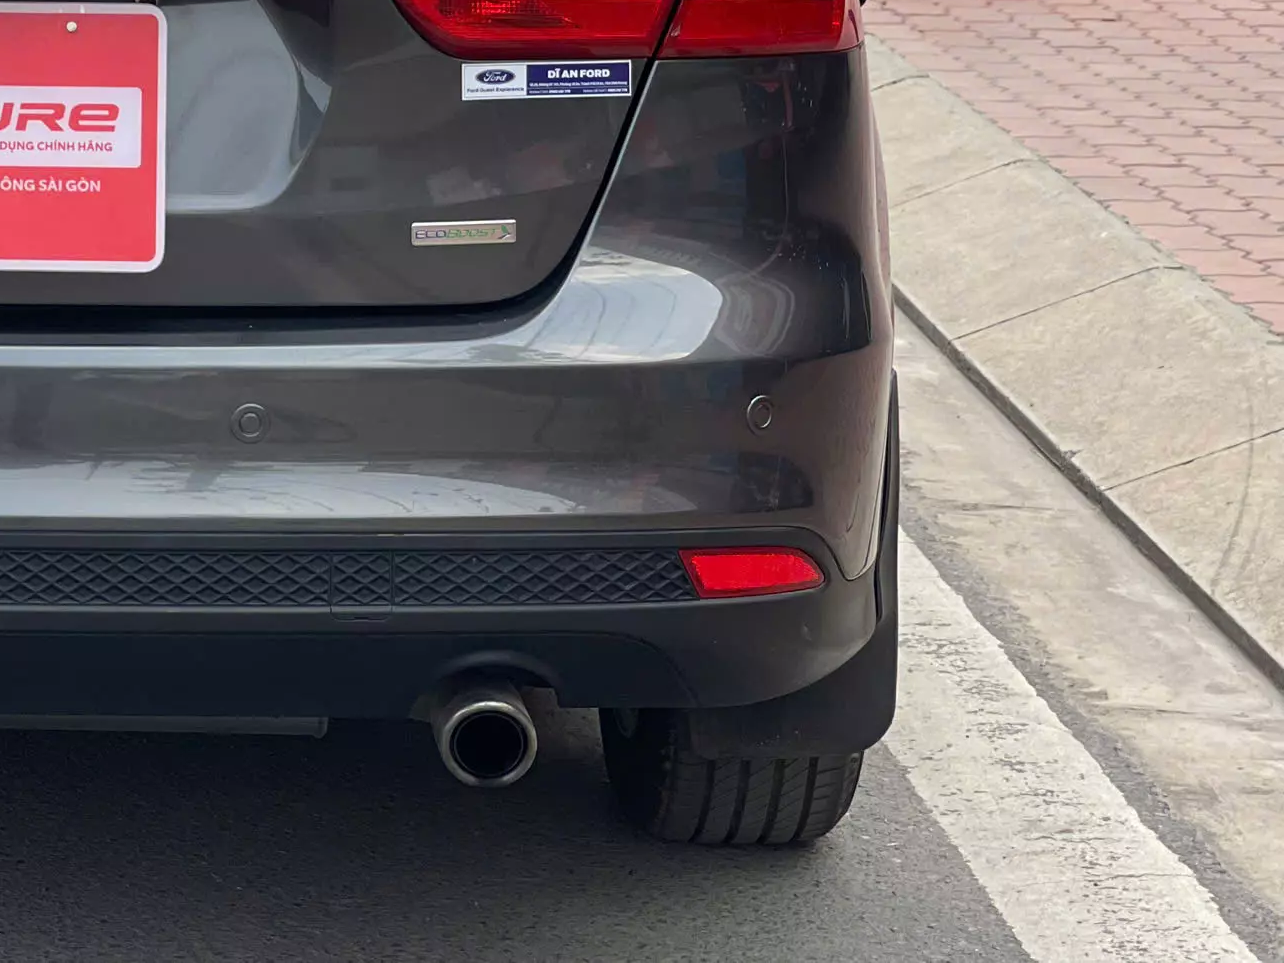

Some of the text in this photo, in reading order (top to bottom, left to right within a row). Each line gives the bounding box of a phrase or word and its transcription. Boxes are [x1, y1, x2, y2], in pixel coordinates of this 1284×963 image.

[483, 71, 508, 82] Ford
[561, 69, 578, 79] AN
[579, 69, 611, 78] FORD
[0, 140, 35, 153] DỤNG
[37, 138, 75, 152] CHÍNH
[78, 139, 114, 152] HÃNG
[38, 177, 63, 192] SÀI
[65, 177, 102, 193] GÒN
